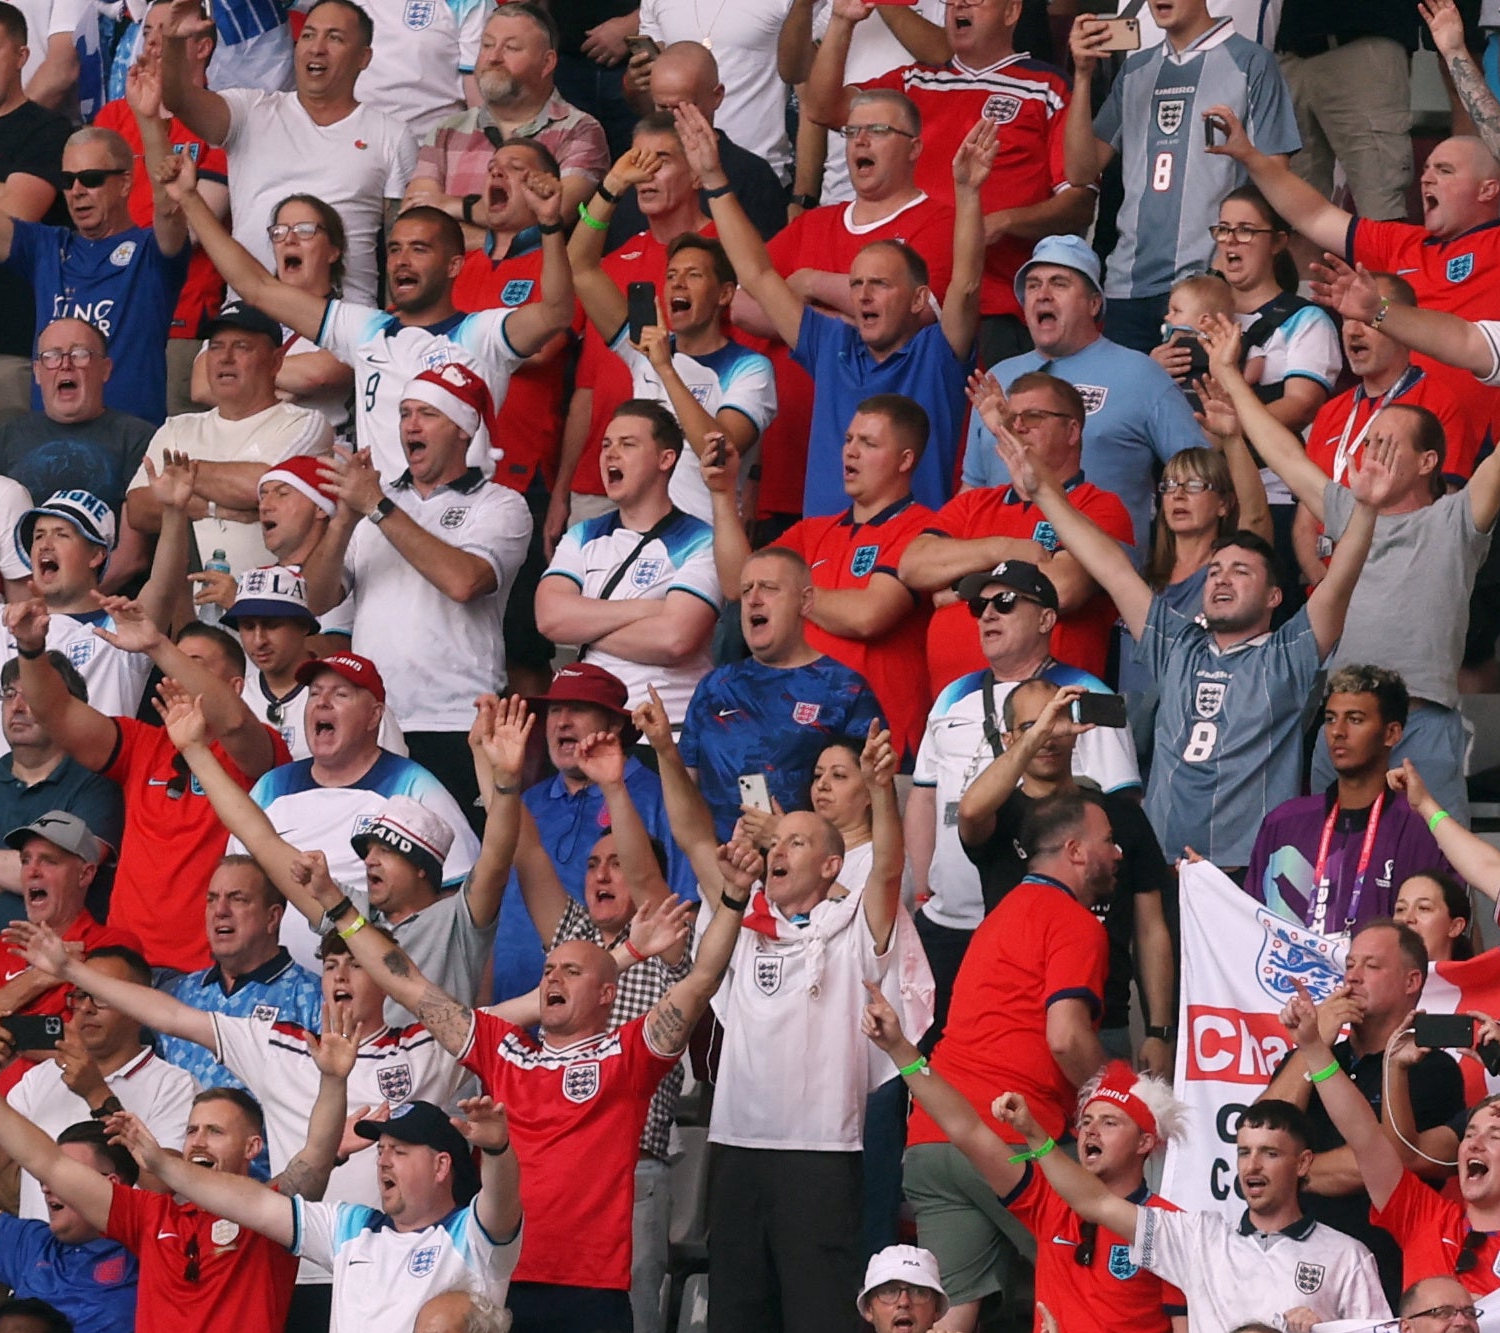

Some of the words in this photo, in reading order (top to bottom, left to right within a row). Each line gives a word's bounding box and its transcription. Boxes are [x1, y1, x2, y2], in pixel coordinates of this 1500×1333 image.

[1154, 86, 1196, 96] UMBRO
[1152, 151, 1174, 192] 8
[52, 297, 114, 319] KING
[365, 371, 381, 412] 9
[1183, 720, 1219, 763] 8
